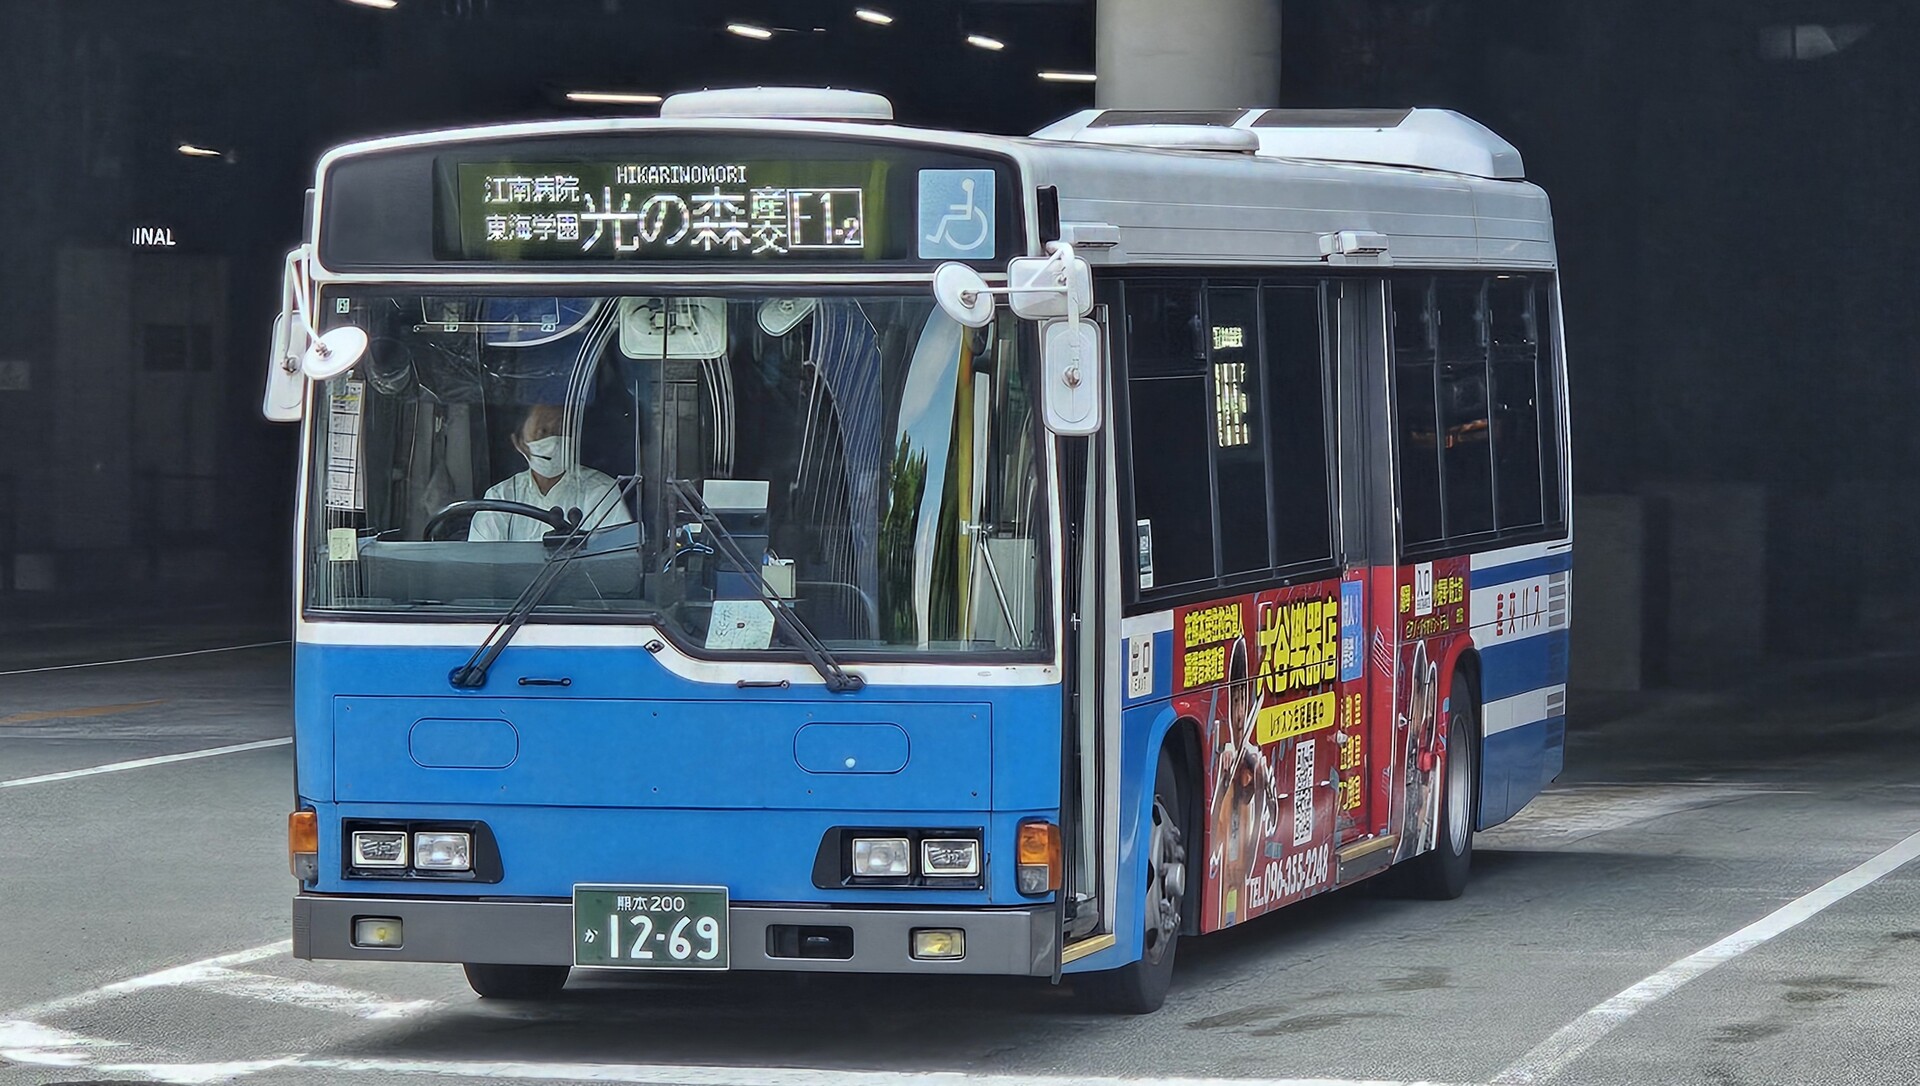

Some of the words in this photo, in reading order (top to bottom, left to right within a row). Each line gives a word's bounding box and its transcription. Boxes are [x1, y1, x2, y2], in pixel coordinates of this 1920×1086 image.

[617, 165, 747, 184] HIKARINOMORI
[485, 175, 580, 203] 江南病院
[132, 227, 177, 246] INAL
[485, 213, 579, 240] 東海学園
[610, 914, 719, 960] 12-69
